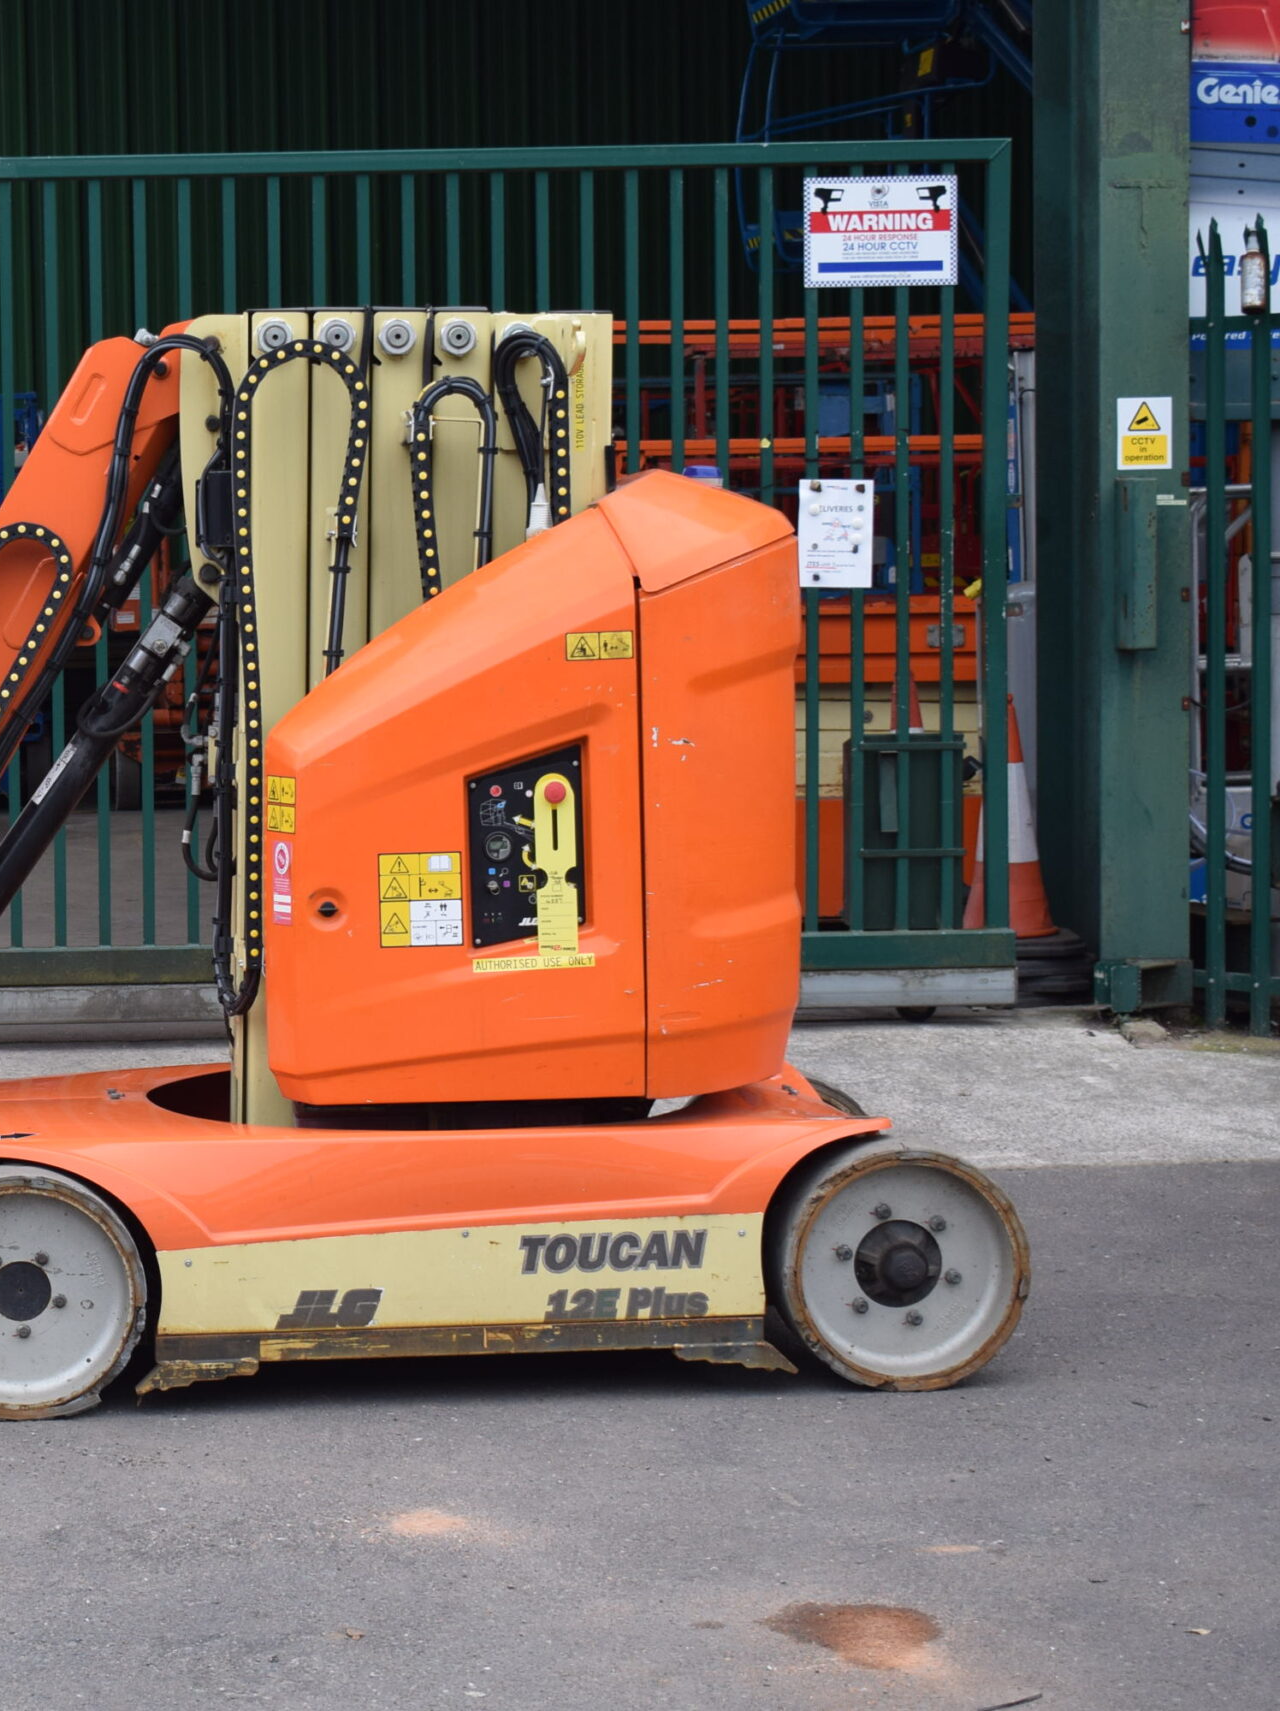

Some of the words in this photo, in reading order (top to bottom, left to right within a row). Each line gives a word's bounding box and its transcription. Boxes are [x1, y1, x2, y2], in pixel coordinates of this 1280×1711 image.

[1197, 77, 1279, 104] Genie
[827, 212, 933, 231] WARNING
[842, 243, 855, 251] 24
[858, 242, 887, 251] HOUR
[889, 242, 919, 250] CCTV
[878, 233, 918, 241] RESPONSE
[575, 403, 584, 424] LEAD
[575, 429, 584, 448] 110V
[1130, 437, 1156, 445] CCTV
[1124, 454, 1165, 462] operation
[475, 958, 538, 970] AUTHORISED
[543, 957, 562, 968] USE
[568, 955, 594, 966] ONLY
[520, 1229, 708, 1275] TOUCAN
[274, 1288, 383, 1330] JLG
[544, 1287, 622, 1323] 12E
[625, 1286, 710, 1319] Plus
